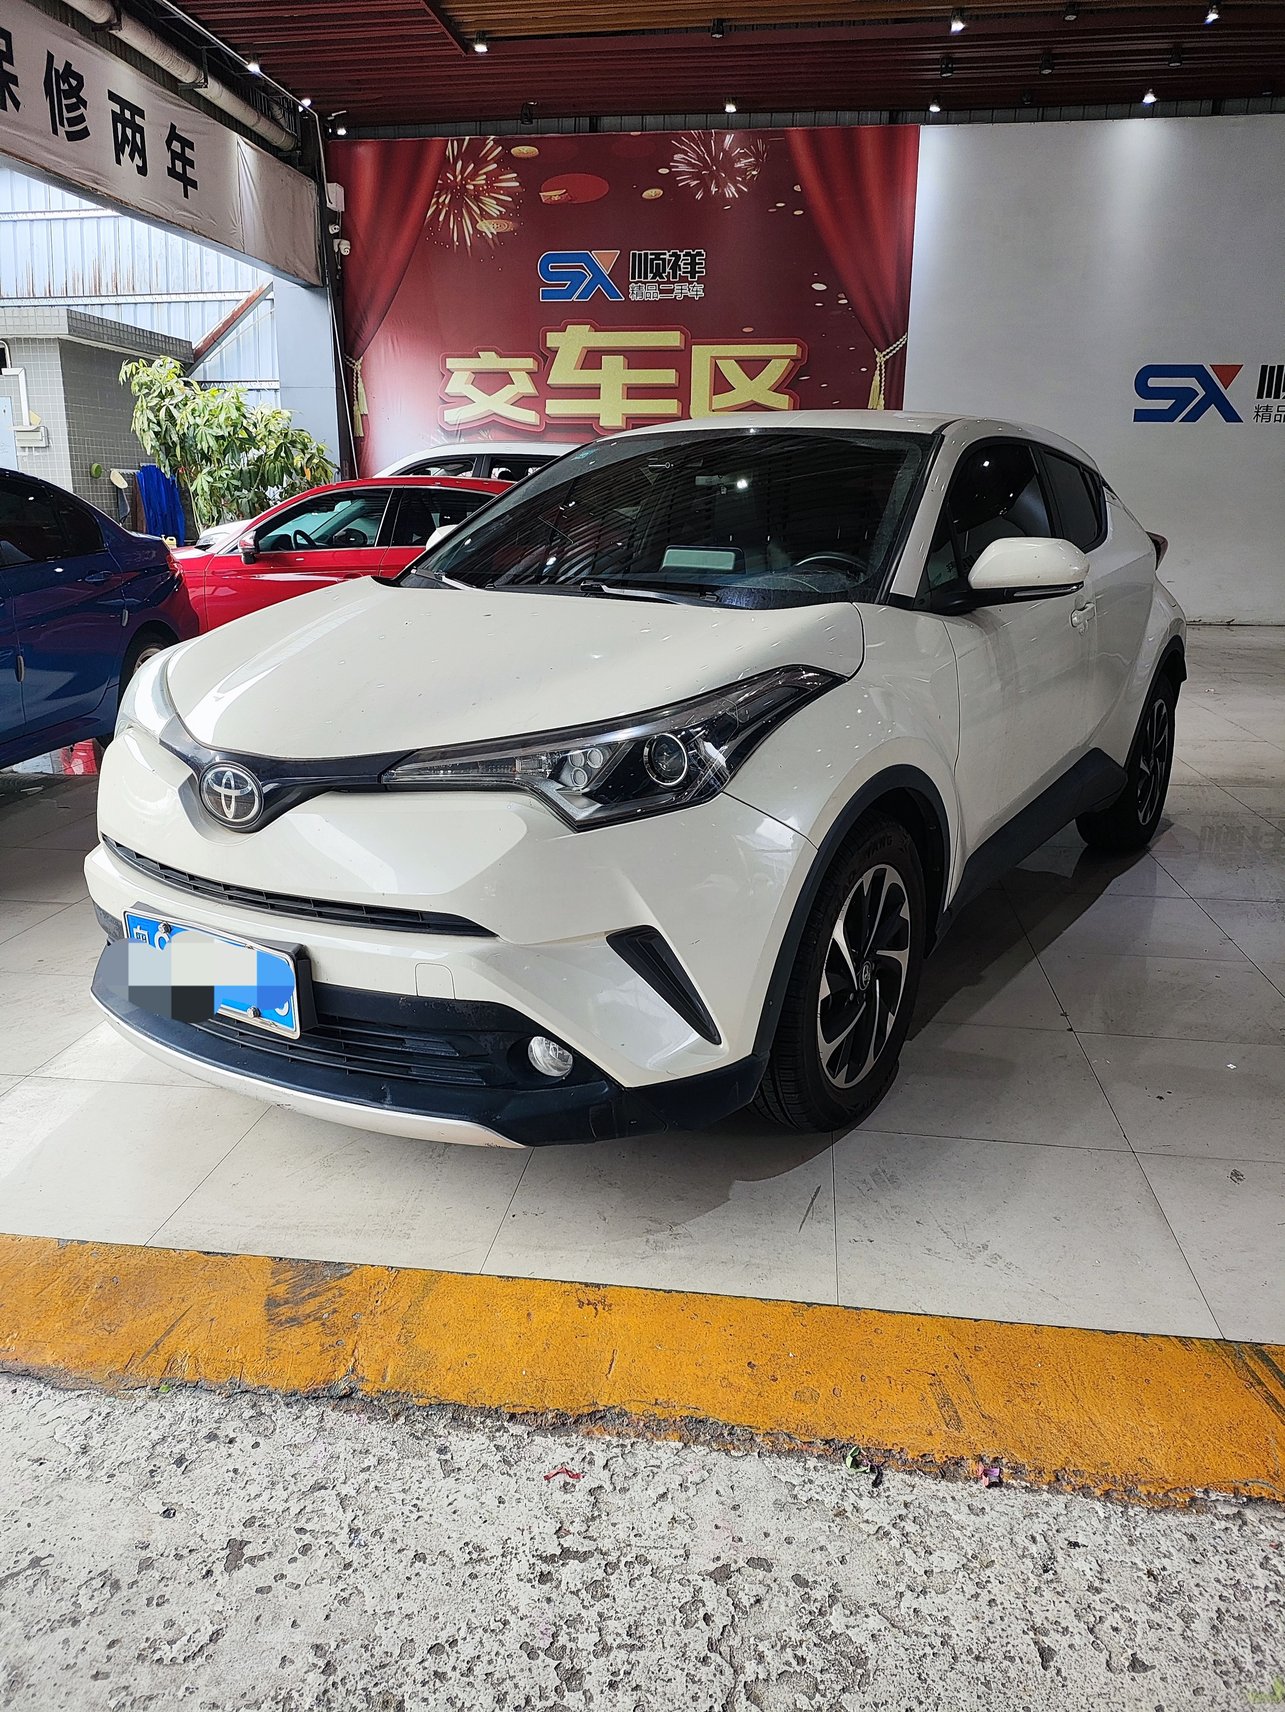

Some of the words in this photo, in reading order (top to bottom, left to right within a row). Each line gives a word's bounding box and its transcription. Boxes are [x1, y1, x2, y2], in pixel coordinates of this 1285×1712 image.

[538, 250, 624, 301] SX
[630, 250, 706, 281] 顺祥
[629, 282, 705, 301] 精品二手车
[443, 324, 802, 430] 交车区
[1132, 364, 1244, 423] SX
